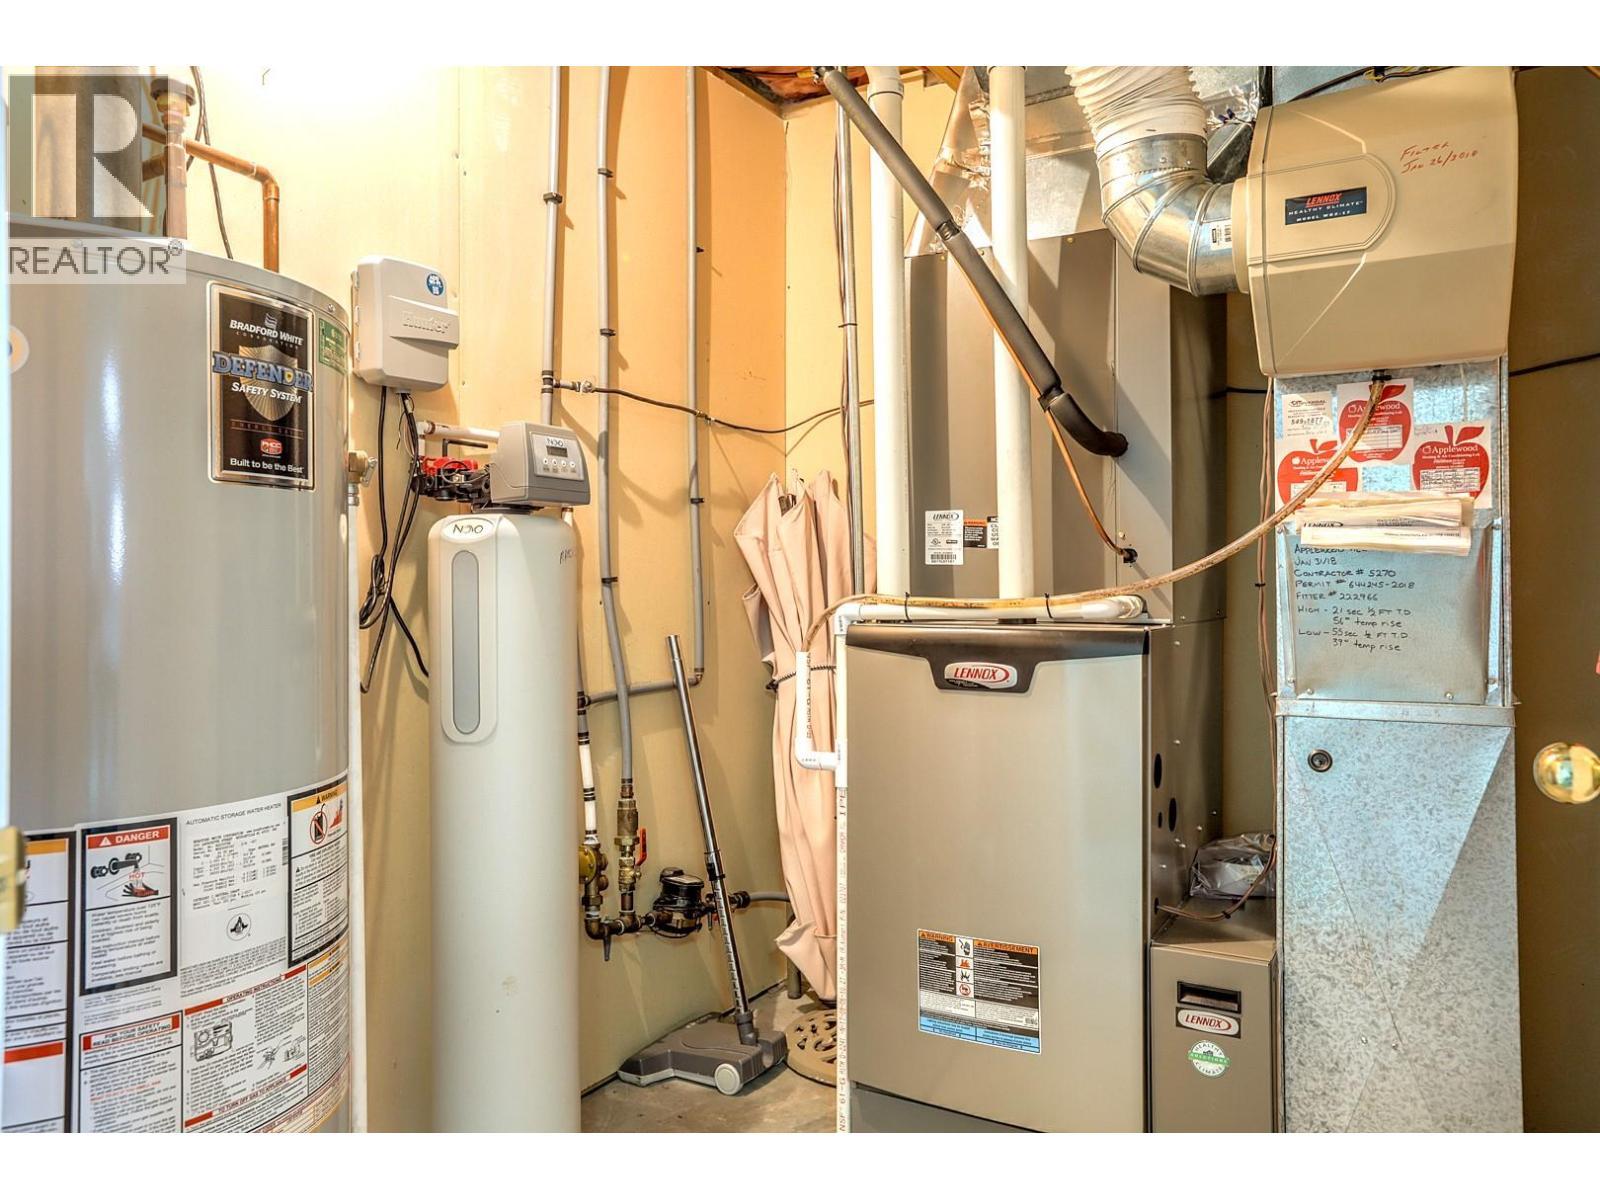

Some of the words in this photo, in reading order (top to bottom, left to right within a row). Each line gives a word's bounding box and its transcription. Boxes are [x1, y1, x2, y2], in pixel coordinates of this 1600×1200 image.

[1306, 193, 1342, 205] LENNOX
[1288, 206, 1322, 216] HEALTHY
[1296, 214, 1320, 222] MODEL
[229, 319, 279, 339] BRADFORD
[279, 331, 304, 346] WHITE
[213, 351, 314, 393] DEFENDER
[231, 381, 269, 396] SAFETY
[269, 388, 303, 404] SYSTEM
[1431, 445, 1479, 454] Applewood
[229, 457, 250, 468] Built
[251, 460, 261, 468] to
[262, 461, 273, 470] be
[274, 462, 286, 471] the
[287, 464, 303, 473] Best
[1294, 558, 1312, 566] JAN
[1294, 569, 1354, 577] CONTRACTOR
[1368, 569, 1397, 577] 5270
[1295, 580, 1331, 588] PERMIT
[1296, 592, 1326, 600] FITTER
[1332, 606, 1343, 615] 21
[1354, 617, 1378, 628] temp
[1353, 640, 1376, 653] temp
[1379, 644, 1402, 652] rise
[954, 667, 999, 680] LENNOX
[186, 815, 220, 826] AUTOMATIC
[220, 810, 246, 820] STORAGE
[246, 807, 264, 815] WATER
[115, 831, 160, 844] DANGER
[129, 871, 146, 880] HOT
[137, 1022, 161, 1031] SAFETY
[1184, 1014, 1223, 1029] LENNOX
[137, 1024, 171, 1036] OPERATING
[1194, 1042, 1224, 1056] HEALTHY
[838, 1112, 846, 1132] NSF
